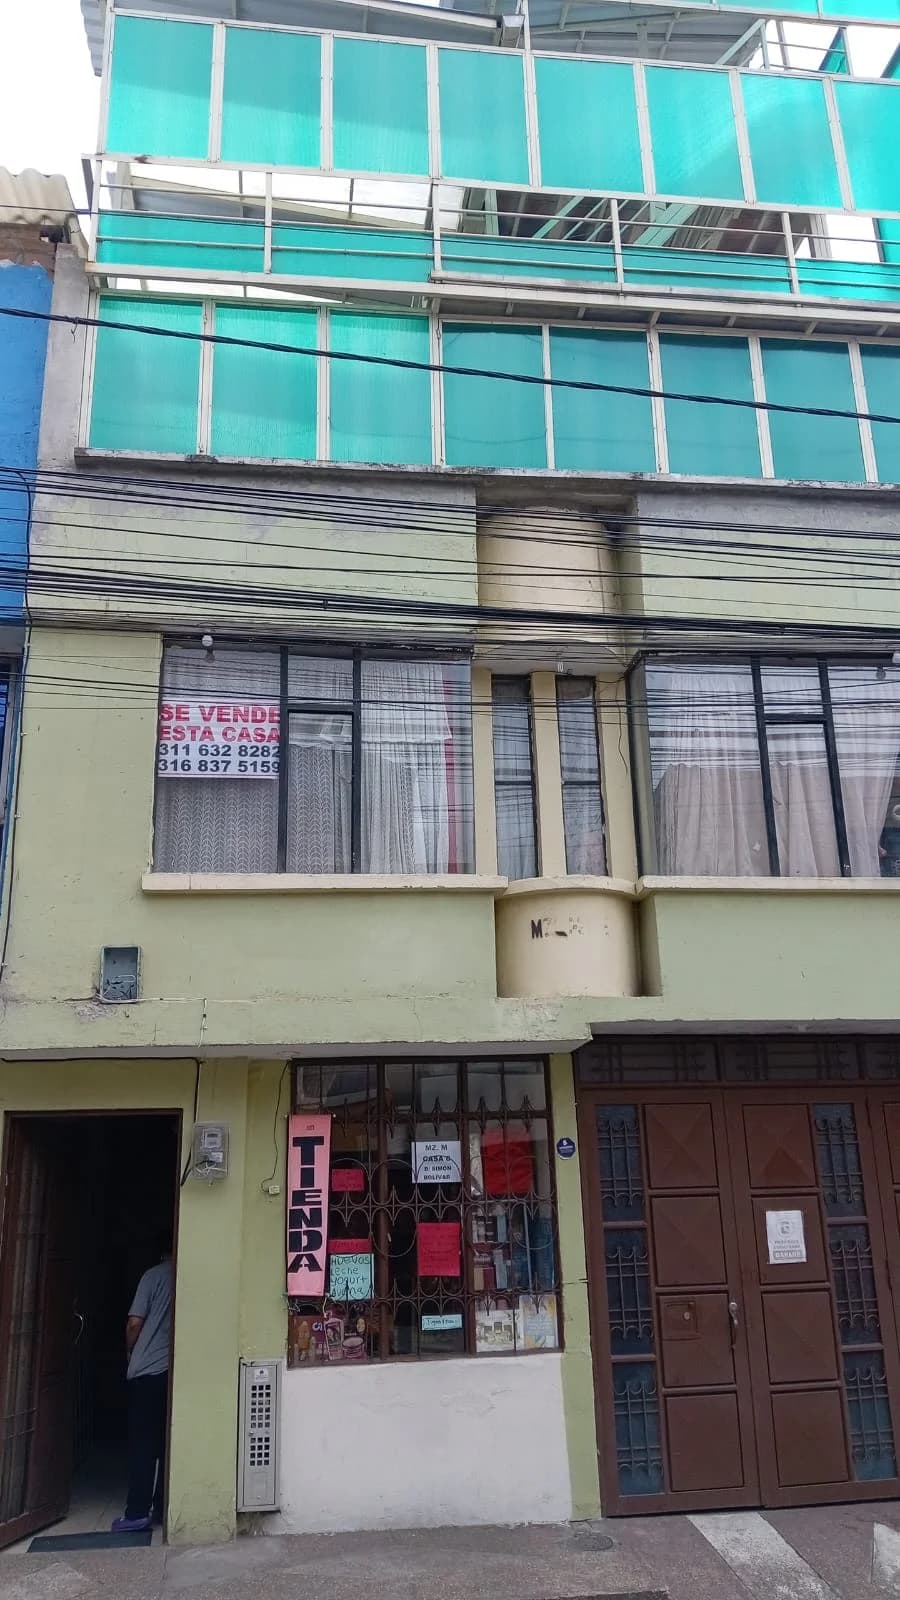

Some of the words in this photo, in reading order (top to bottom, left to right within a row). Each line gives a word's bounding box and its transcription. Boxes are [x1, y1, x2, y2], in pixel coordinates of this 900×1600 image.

[160, 704, 190, 722] SE
[198, 704, 280, 723] VENDE
[160, 725, 215, 742] ESTA
[221, 727, 280, 743] CASA
[160, 743, 190, 756] 311
[198, 744, 232, 757] 632
[238, 745, 280, 758] 8282
[159, 759, 192, 772] 316
[198, 760, 231, 773] 837
[238, 760, 280, 773] 5159
[288, 1136, 325, 1274] TIENDA
